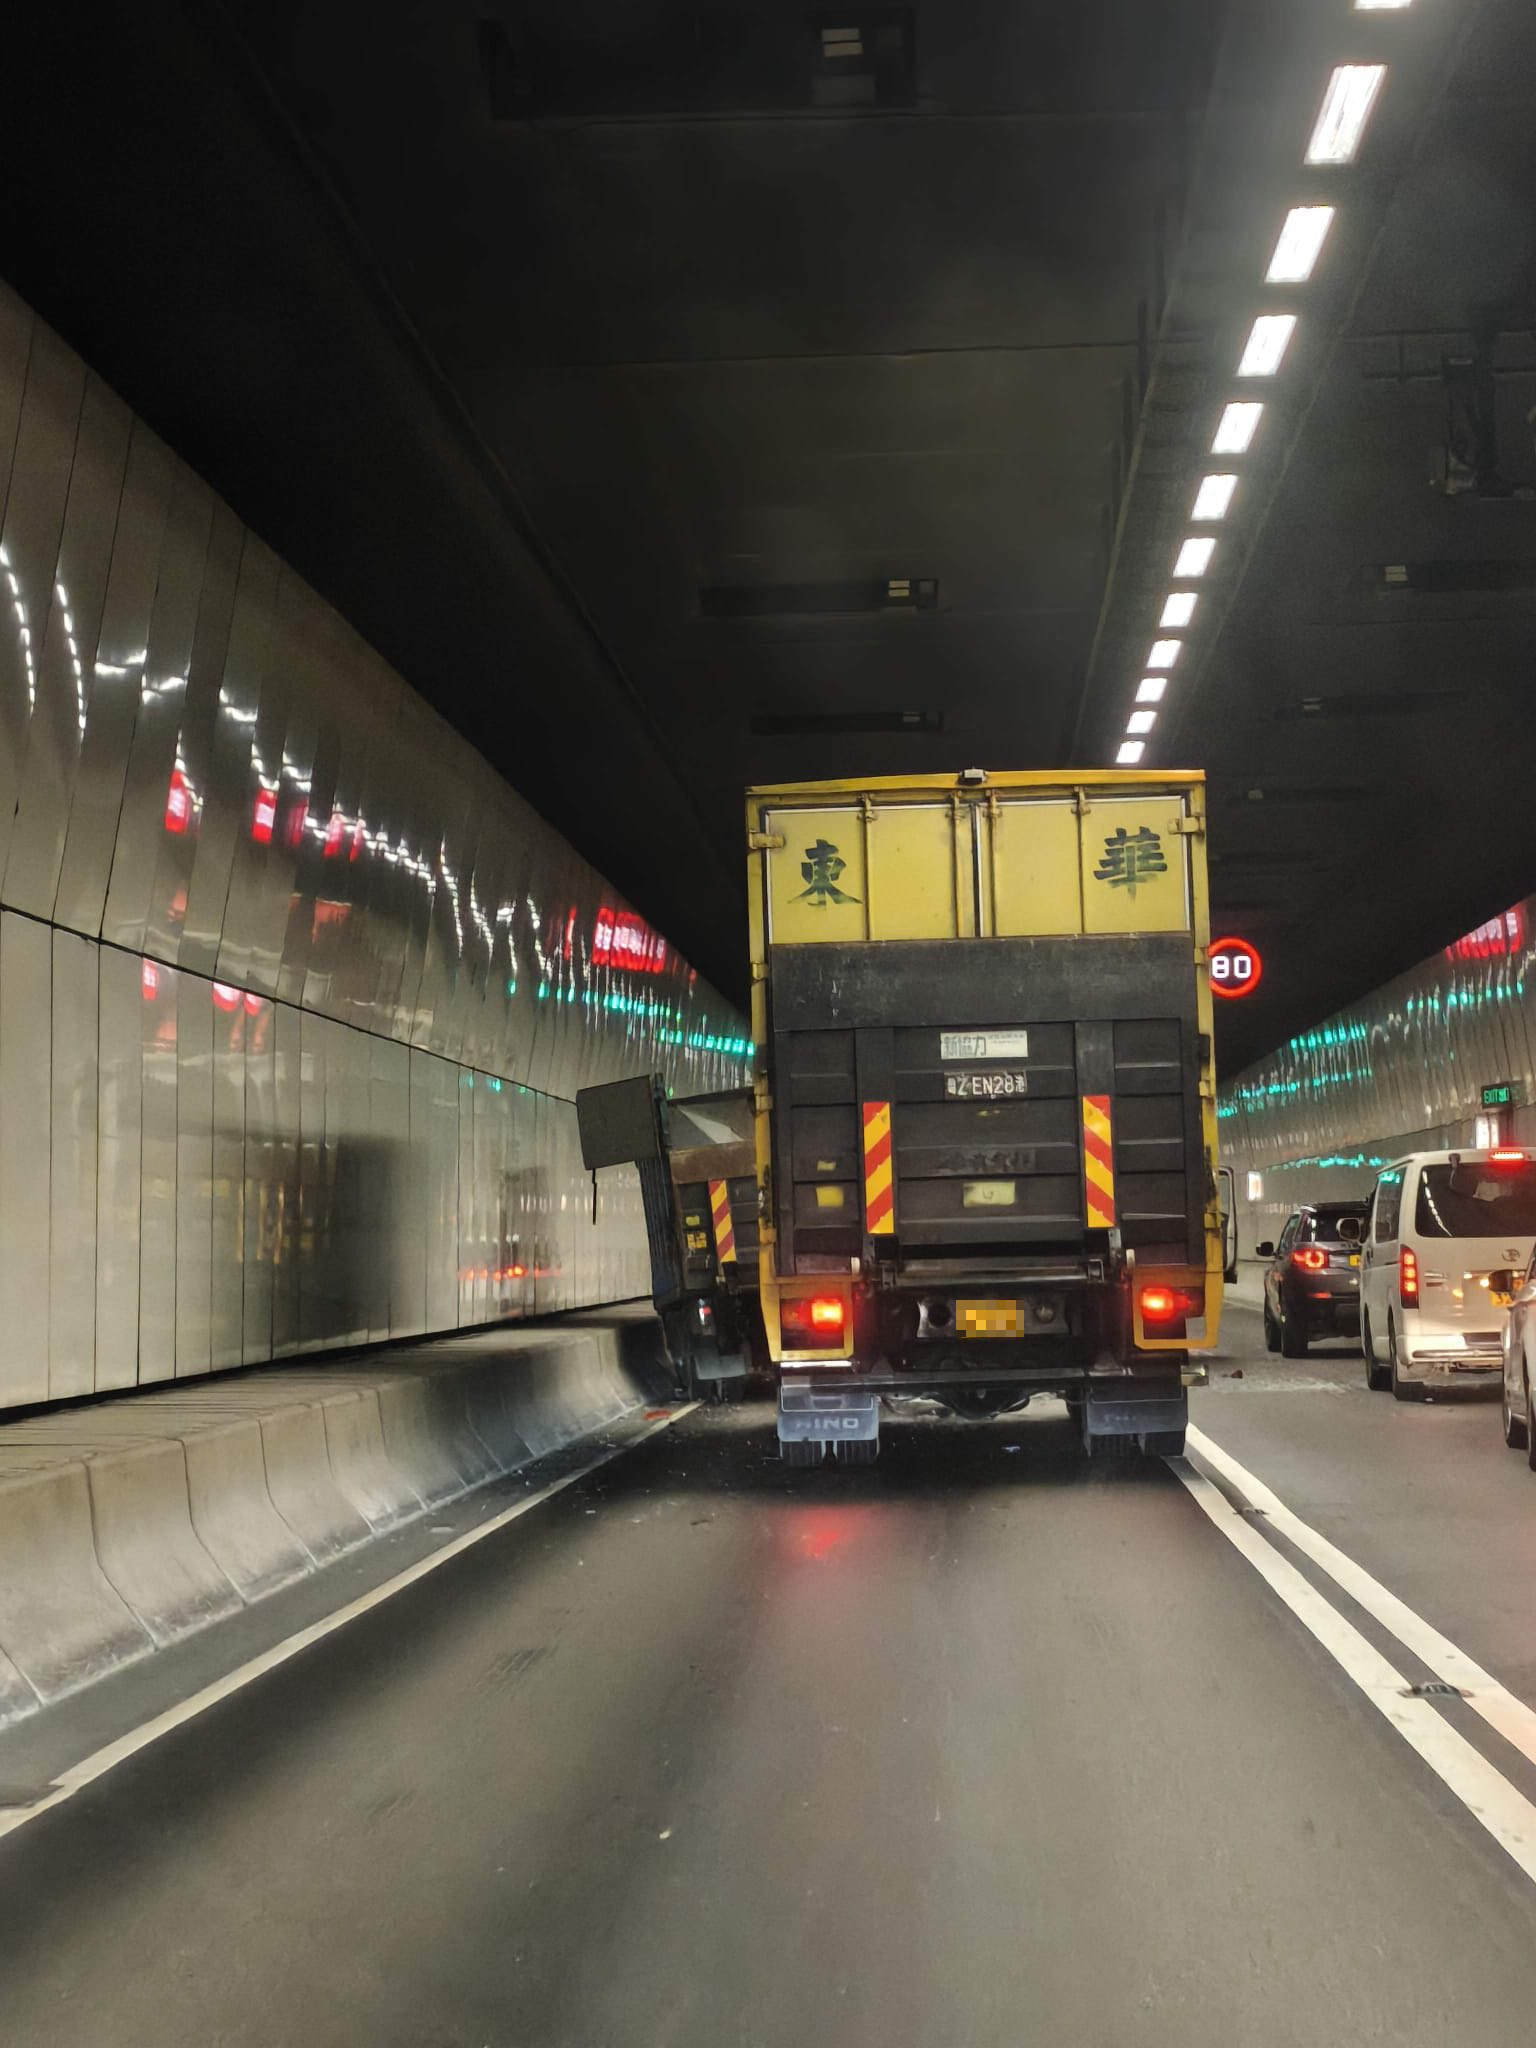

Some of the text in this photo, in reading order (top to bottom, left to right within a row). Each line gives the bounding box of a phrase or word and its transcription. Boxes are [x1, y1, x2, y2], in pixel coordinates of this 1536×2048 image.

[788, 826, 1168, 908] 東 華
[1212, 956, 1251, 979] 80
